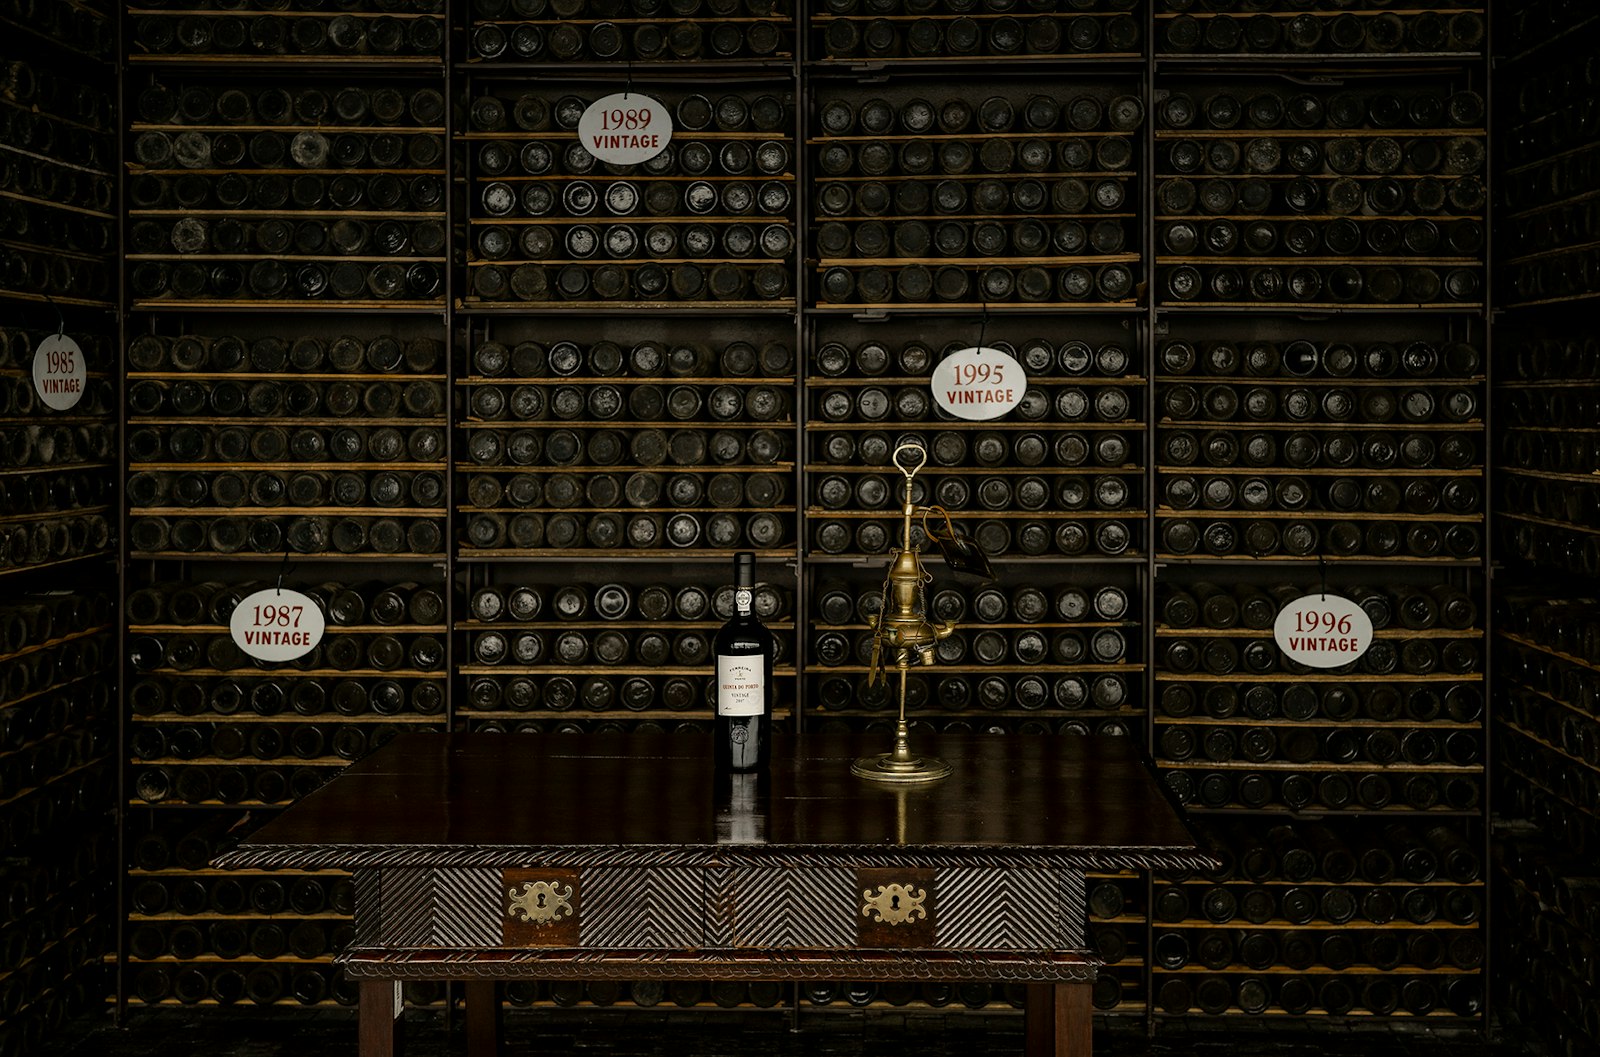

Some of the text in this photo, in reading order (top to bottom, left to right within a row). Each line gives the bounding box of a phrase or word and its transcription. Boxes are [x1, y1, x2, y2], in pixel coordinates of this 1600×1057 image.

[601, 110, 652, 130] 1989
[593, 134, 658, 149] VINTAGE
[46, 351, 75, 374] 1985
[954, 364, 1004, 386] 1995
[42, 378, 80, 394] VINTAGE
[946, 389, 1013, 404] VINTAGE
[252, 605, 304, 628] 1987
[1294, 611, 1352, 635] 1996
[244, 631, 311, 647] VINTAGE
[1289, 637, 1358, 653] VINTAGE
